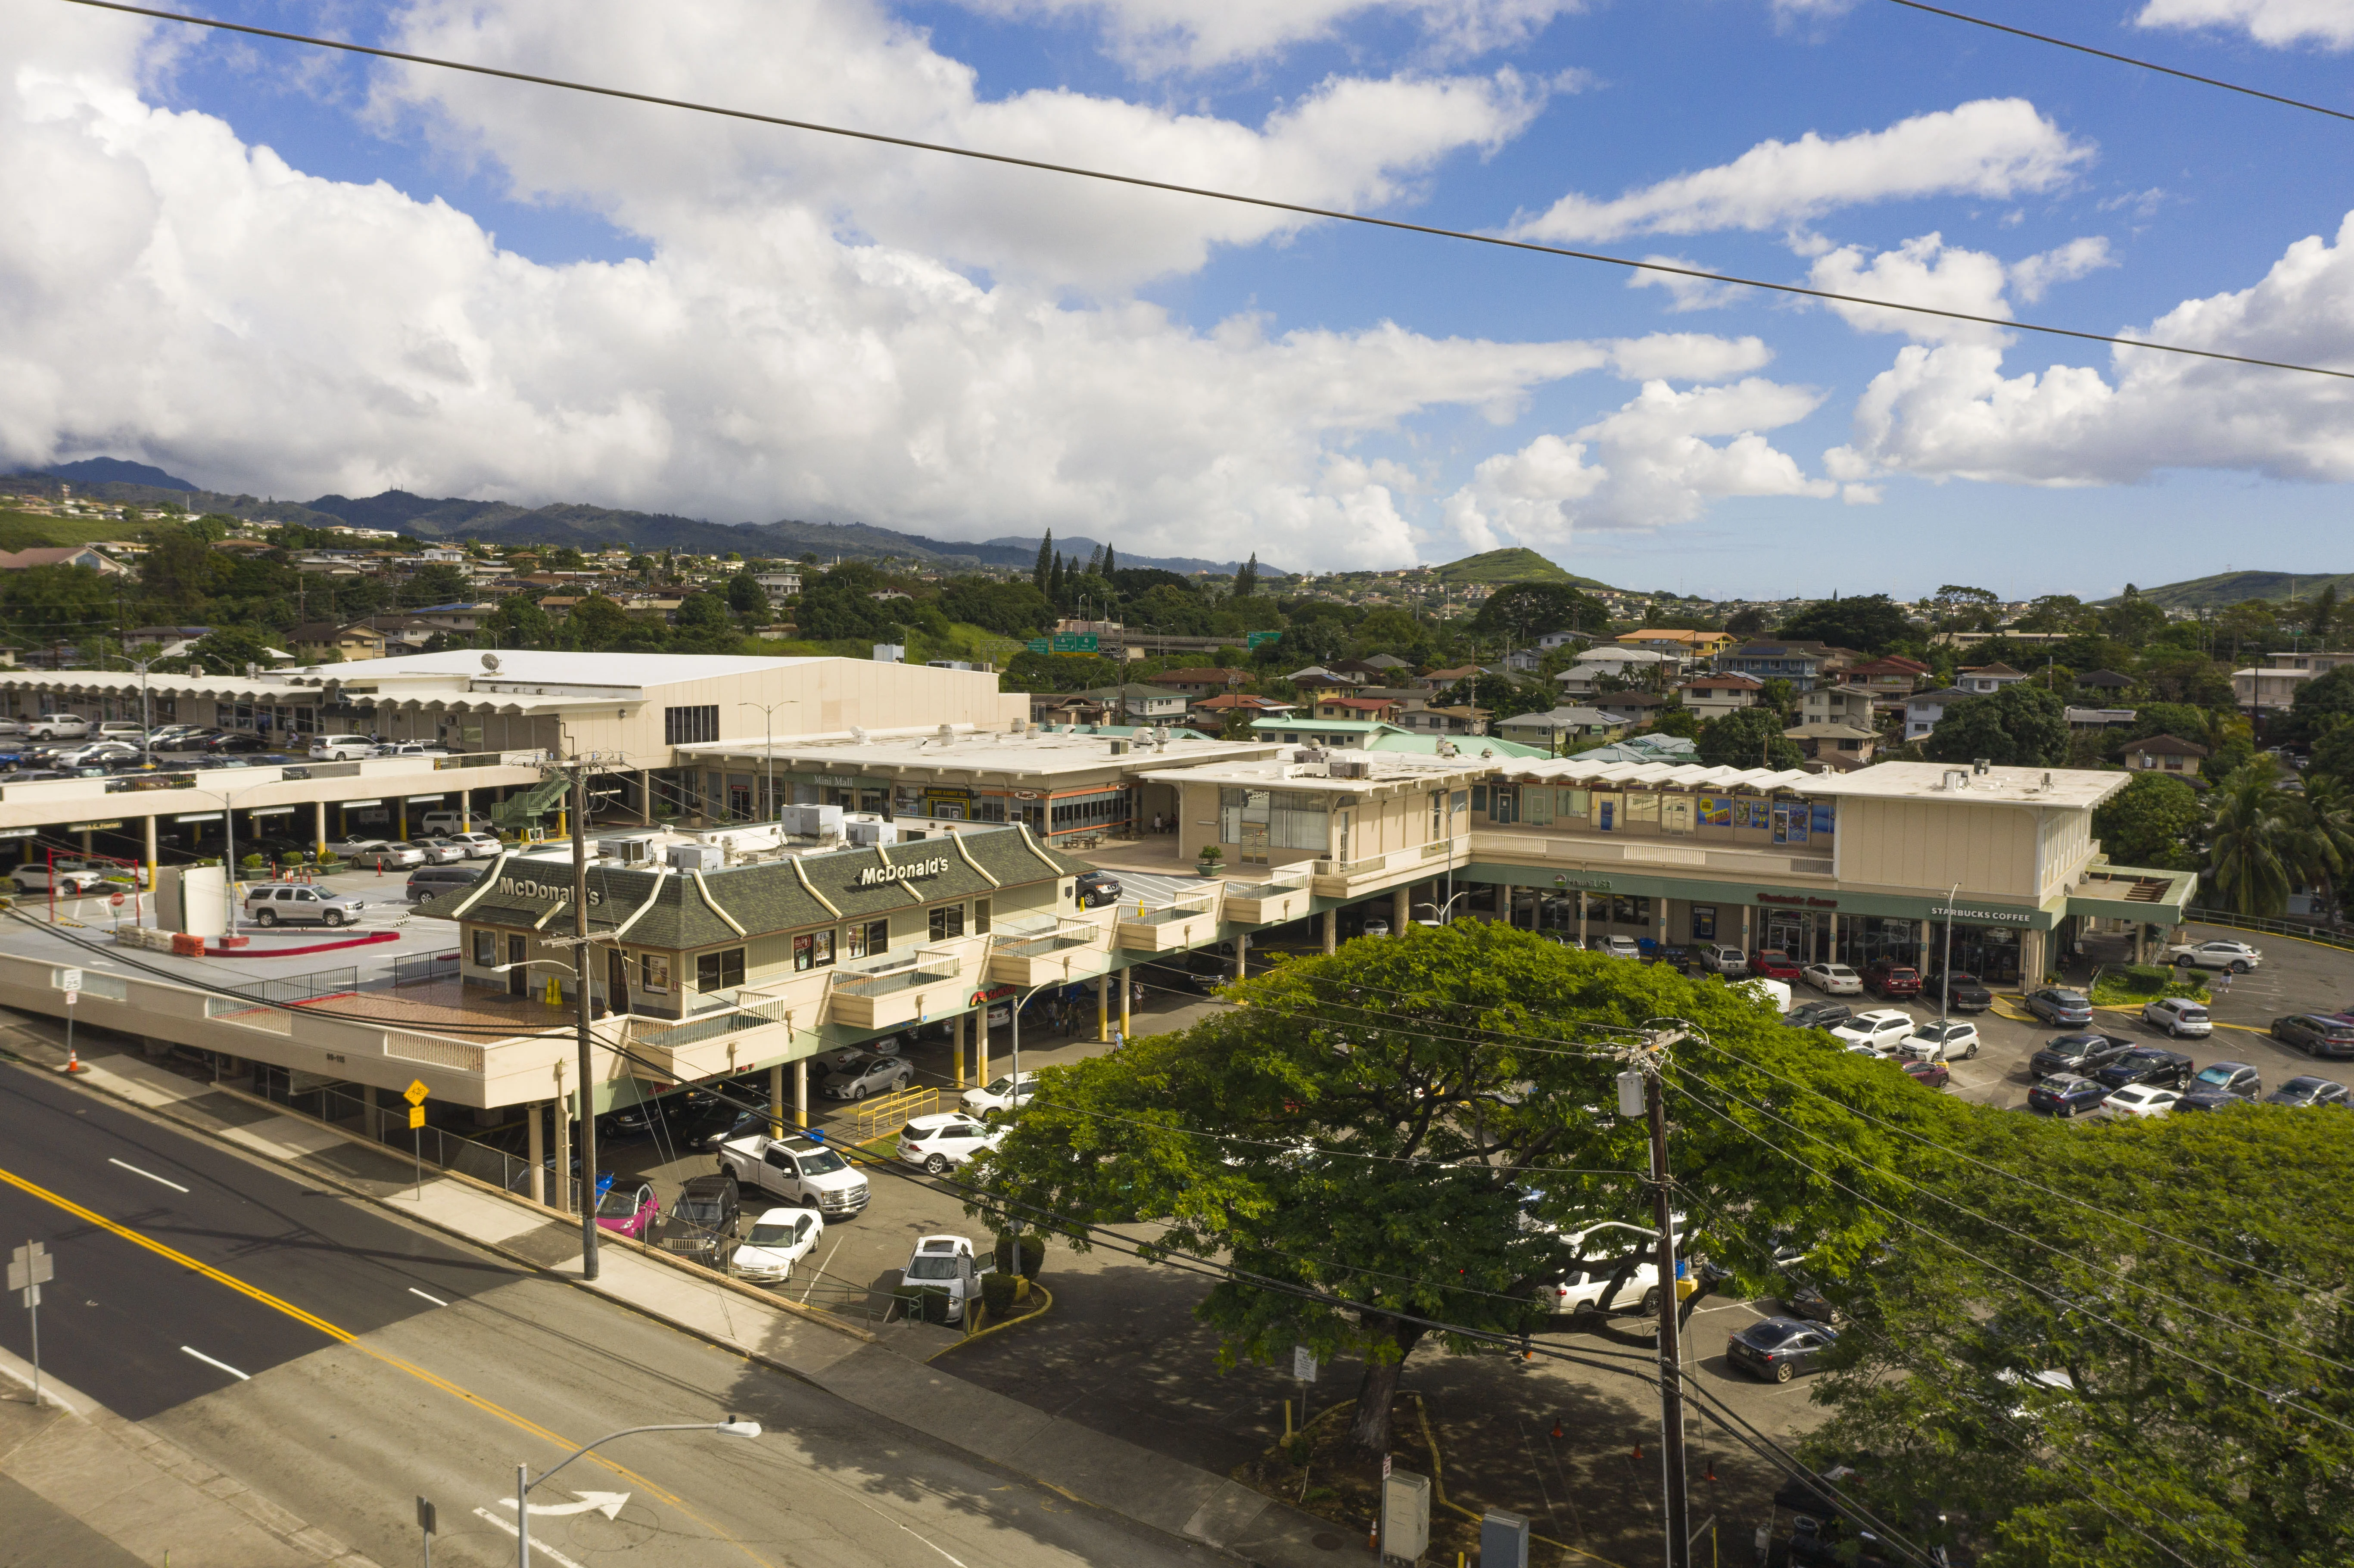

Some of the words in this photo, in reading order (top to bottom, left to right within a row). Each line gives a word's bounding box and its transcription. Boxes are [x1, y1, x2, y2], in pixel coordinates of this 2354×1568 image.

[814, 775, 831, 785] Mini
[835, 777, 852, 786] Mall
[861, 857, 948, 885] McDonald's
[1569, 877, 1611, 888] HawaiiUSA
[500, 877, 599, 905] McDonal's
[1931, 907, 1990, 918] STARBUCKS
[1992, 912, 2030, 922] COFFEE
[802, 938, 807, 946] $1
[66, 980, 80, 989] 25
[988, 985, 1017, 1001] SAMURAI
